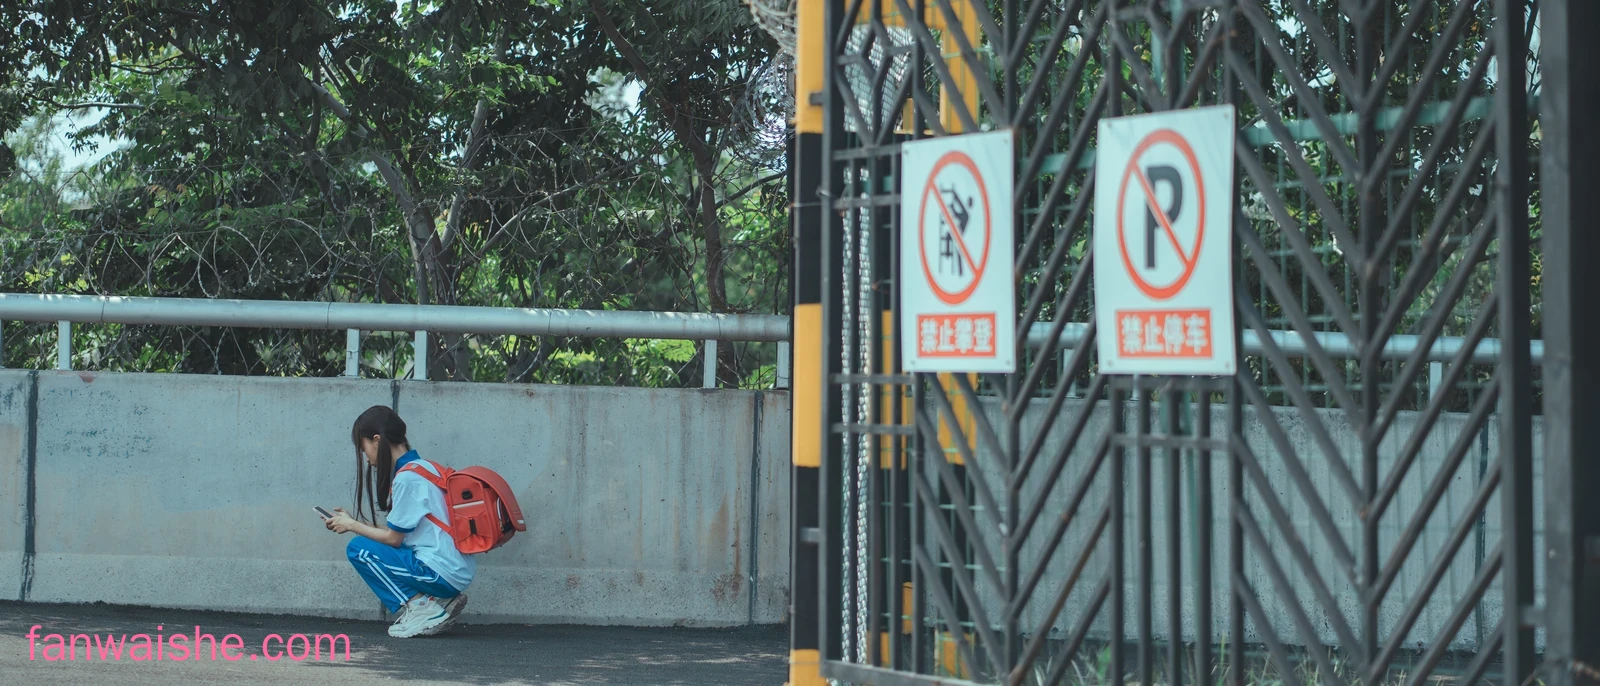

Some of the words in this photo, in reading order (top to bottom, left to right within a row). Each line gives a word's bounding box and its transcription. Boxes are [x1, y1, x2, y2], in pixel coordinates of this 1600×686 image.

[1145, 165, 1183, 270] P
[921, 317, 993, 354] 禁止攀登
[1121, 313, 1208, 354] 禁止停车
